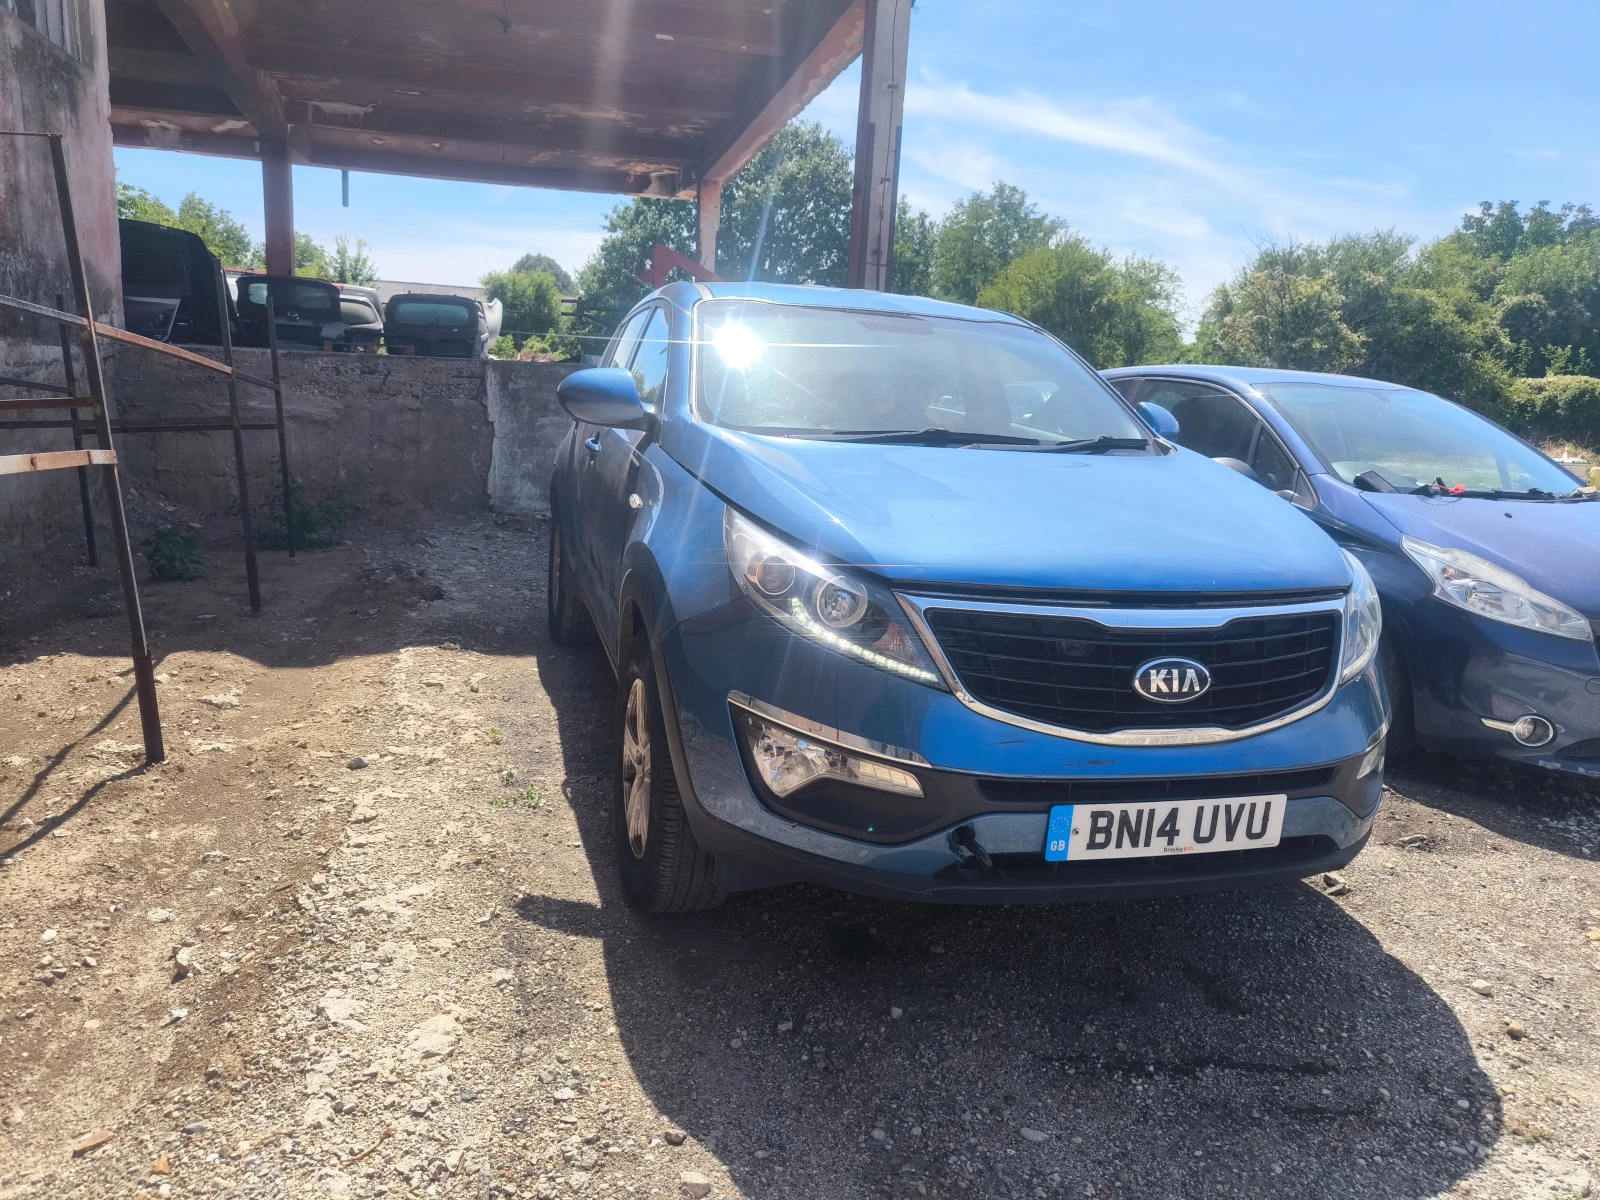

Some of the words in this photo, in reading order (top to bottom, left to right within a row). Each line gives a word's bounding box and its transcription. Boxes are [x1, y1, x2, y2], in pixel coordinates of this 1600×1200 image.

[1149, 668, 1200, 693] KIA
[1086, 807, 1180, 850] BN14
[1193, 801, 1272, 844] UVU
[1050, 840, 1066, 851] GB
